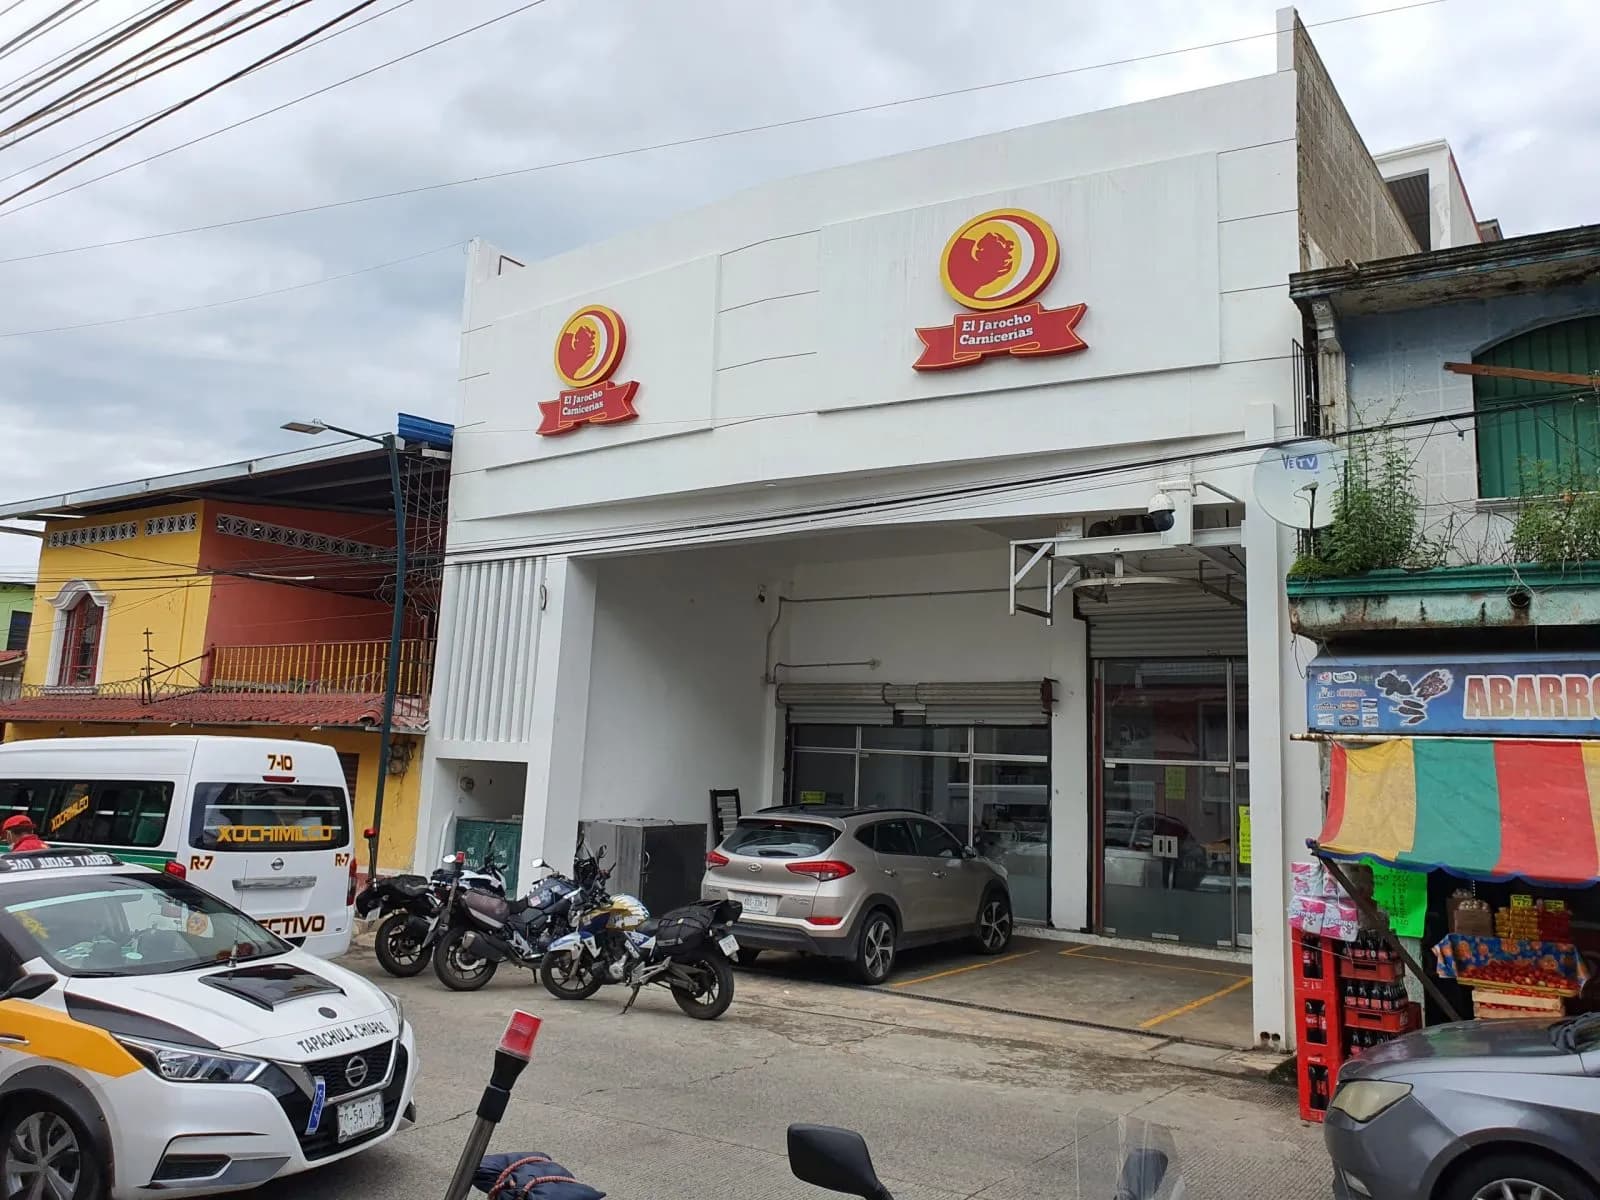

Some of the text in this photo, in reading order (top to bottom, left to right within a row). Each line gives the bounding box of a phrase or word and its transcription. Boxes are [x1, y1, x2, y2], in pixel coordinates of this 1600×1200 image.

[962, 314, 1032, 333] El Jarocho
[564, 390, 603, 406] El Jarocho
[1463, 674, 1600, 720] ABARR
[217, 824, 333, 843] XOCHIMILCO
[6, 854, 113, 870] SAN JUDAS TADEO
